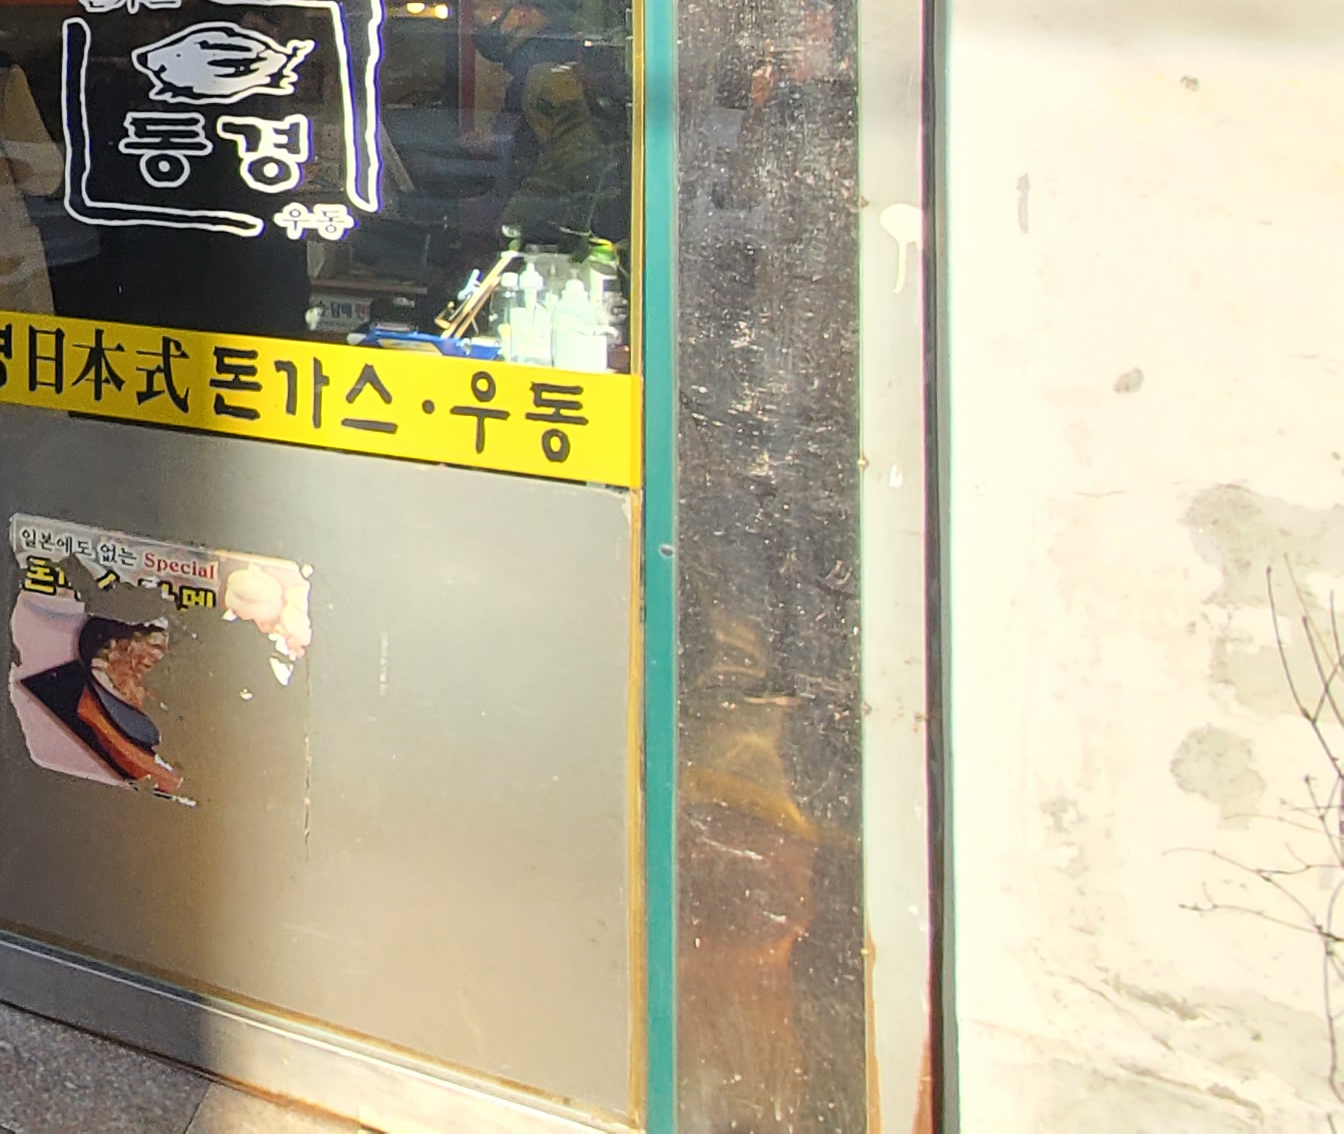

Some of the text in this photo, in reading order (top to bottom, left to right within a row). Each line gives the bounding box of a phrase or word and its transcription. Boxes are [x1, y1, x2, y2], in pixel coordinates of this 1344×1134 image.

[118, 109, 312, 195] 동경
[274, 202, 355, 241] 우동
[20, 528, 93, 558] 일본에도
[98, 543, 137, 566] 없는
[143, 551, 217, 580] Special
